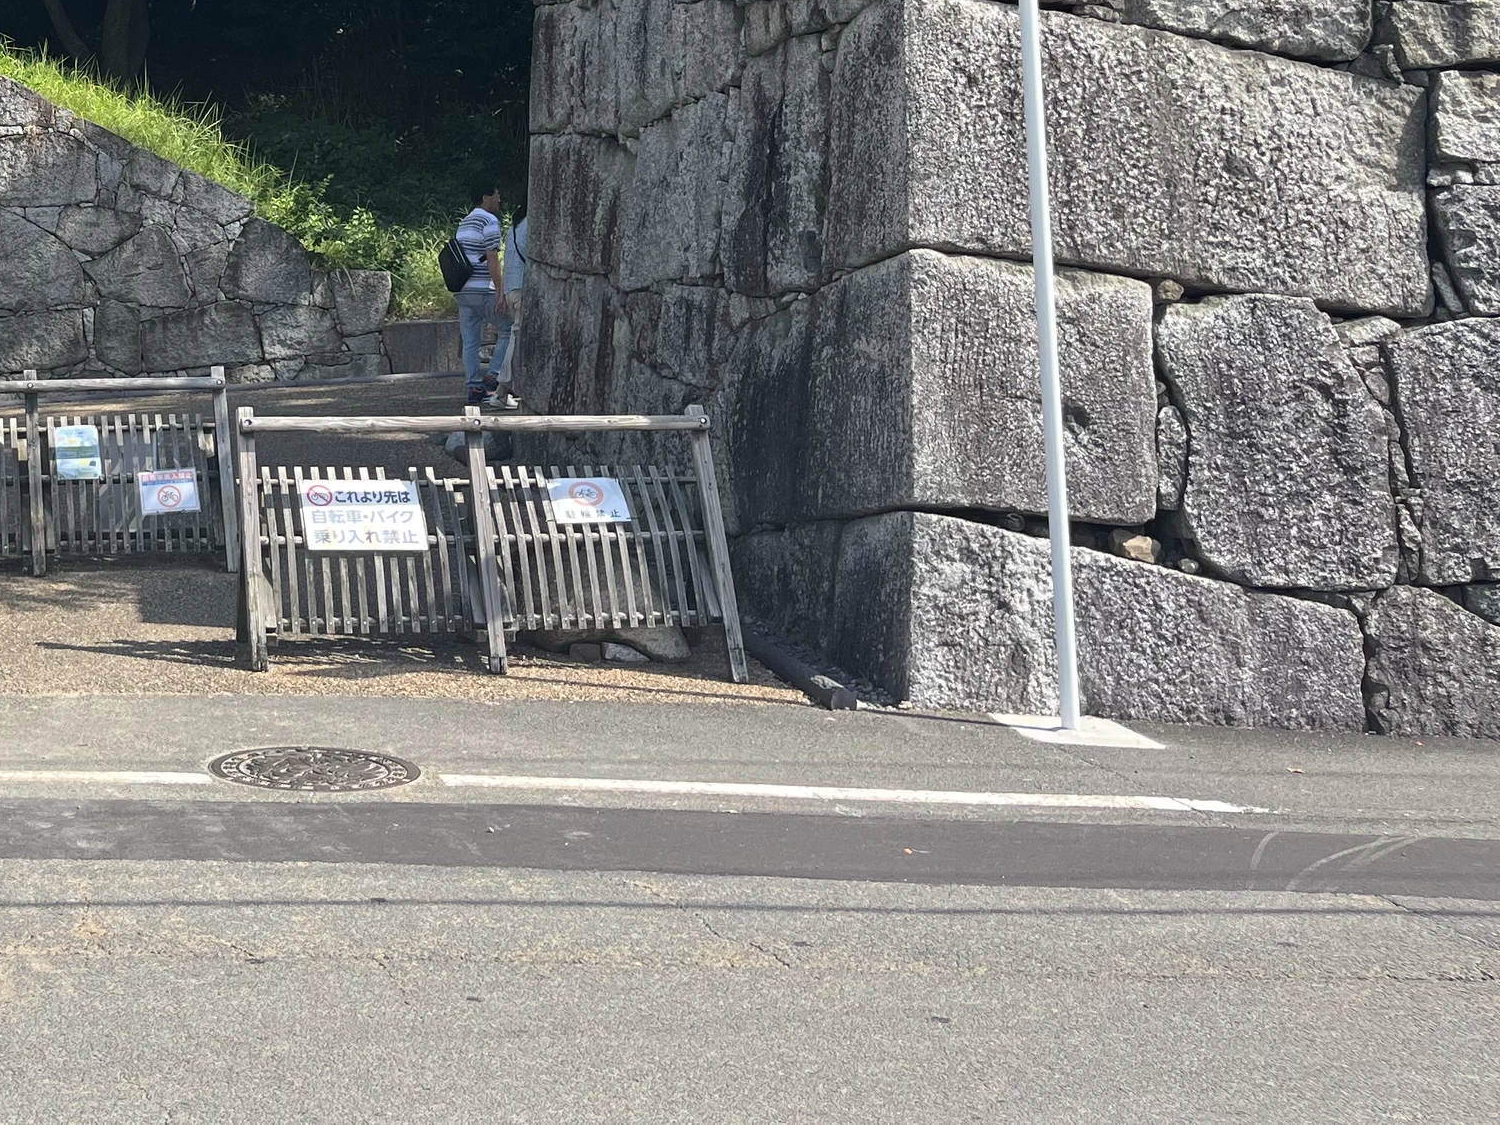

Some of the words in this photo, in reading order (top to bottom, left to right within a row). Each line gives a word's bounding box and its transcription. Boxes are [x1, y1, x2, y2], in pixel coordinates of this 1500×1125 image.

[334, 490, 411, 504] これより先は
[311, 509, 414, 524] 自転車・バイク
[565, 508, 622, 519] 駐輪禁止
[313, 529, 420, 544] 乗り入れ禁止
